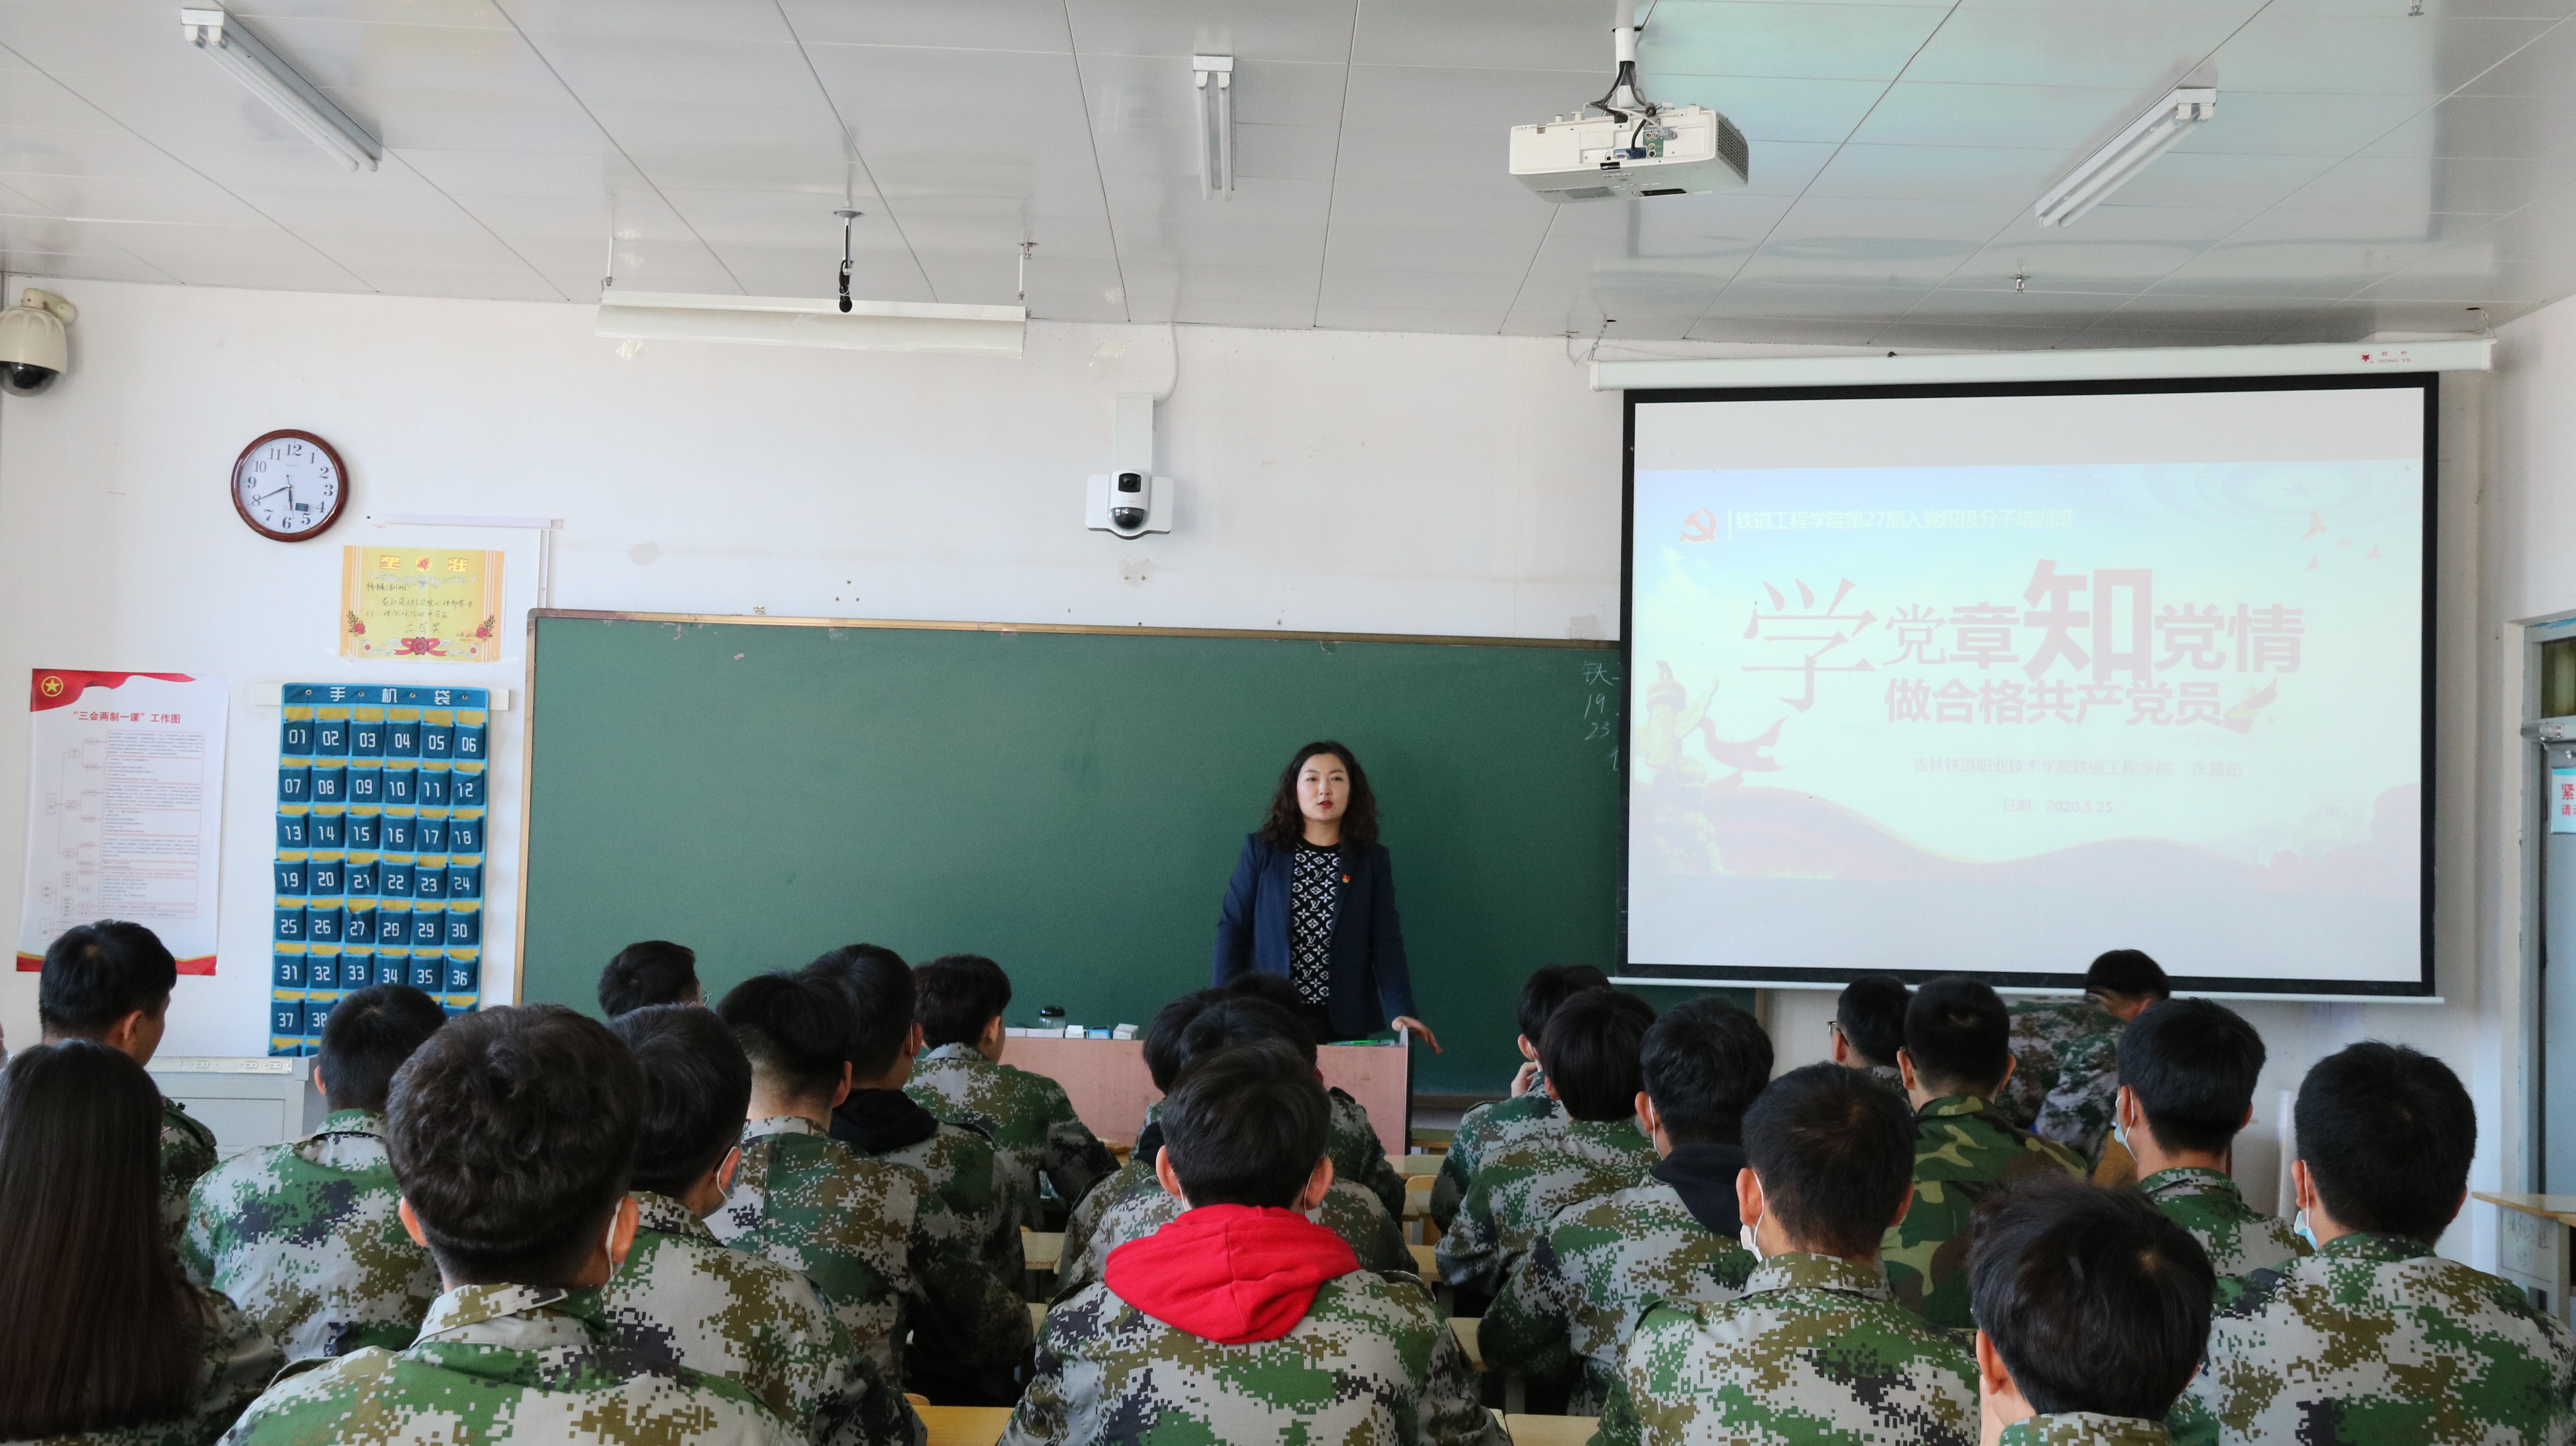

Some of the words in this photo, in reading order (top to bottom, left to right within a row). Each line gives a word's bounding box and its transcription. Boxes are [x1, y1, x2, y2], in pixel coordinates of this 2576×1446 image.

[270, 448, 281, 460] 11
[286, 444, 302, 456] 12
[310, 452, 315, 464] 1
[254, 461, 267, 473] 10
[319, 467, 329, 479] 2
[247, 477, 257, 488] 9
[324, 484, 333, 496] 3
[252, 494, 261, 507] 8
[316, 501, 325, 513] 4
[264, 509, 273, 521] 7
[301, 513, 311, 525] 5
[1735, 508, 2074, 531] 铁道工程学院第27期入党积极分子培训班
[283, 516, 292, 529] 6
[330, 687, 450, 705] 手机袋
[1884, 677, 2223, 726] 做合格共产党员
[289, 729, 305, 744] 01
[323, 731, 339, 746] 02
[360, 732, 375, 747] 03
[395, 733, 410, 748] 04
[429, 735, 444, 750] 05
[462, 737, 476, 752] 06
[1913, 757, 2173, 777] 吉林铁道职业技术学院铁道工程学院
[285, 779, 301, 793] 07
[319, 780, 334, 794] 08
[356, 779, 372, 794] 09
[390, 781, 405, 796] 10
[425, 782, 440, 797] 11
[458, 783, 473, 797] 12
[285, 826, 301, 840] 13
[319, 826, 334, 840] 14
[354, 826, 369, 841] 15
[389, 828, 404, 843] 16
[424, 829, 439, 844] 17
[455, 831, 471, 844] 18
[282, 872, 298, 887] 19
[318, 872, 334, 886] 20
[354, 875, 370, 888] 21
[389, 875, 404, 889] 22
[422, 878, 437, 891] 23
[454, 877, 470, 890] 24
[281, 919, 297, 933] 25
[315, 920, 331, 934] 26
[350, 921, 365, 936] 27
[383, 923, 399, 936] 28
[419, 923, 434, 937] 29
[452, 923, 467, 938] 30
[282, 965, 297, 980] 31
[314, 966, 330, 981] 32
[349, 966, 364, 980] 33
[383, 969, 398, 983] 34
[417, 969, 432, 983] 35
[453, 970, 467, 985] 36
[279, 1013, 293, 1027] 37
